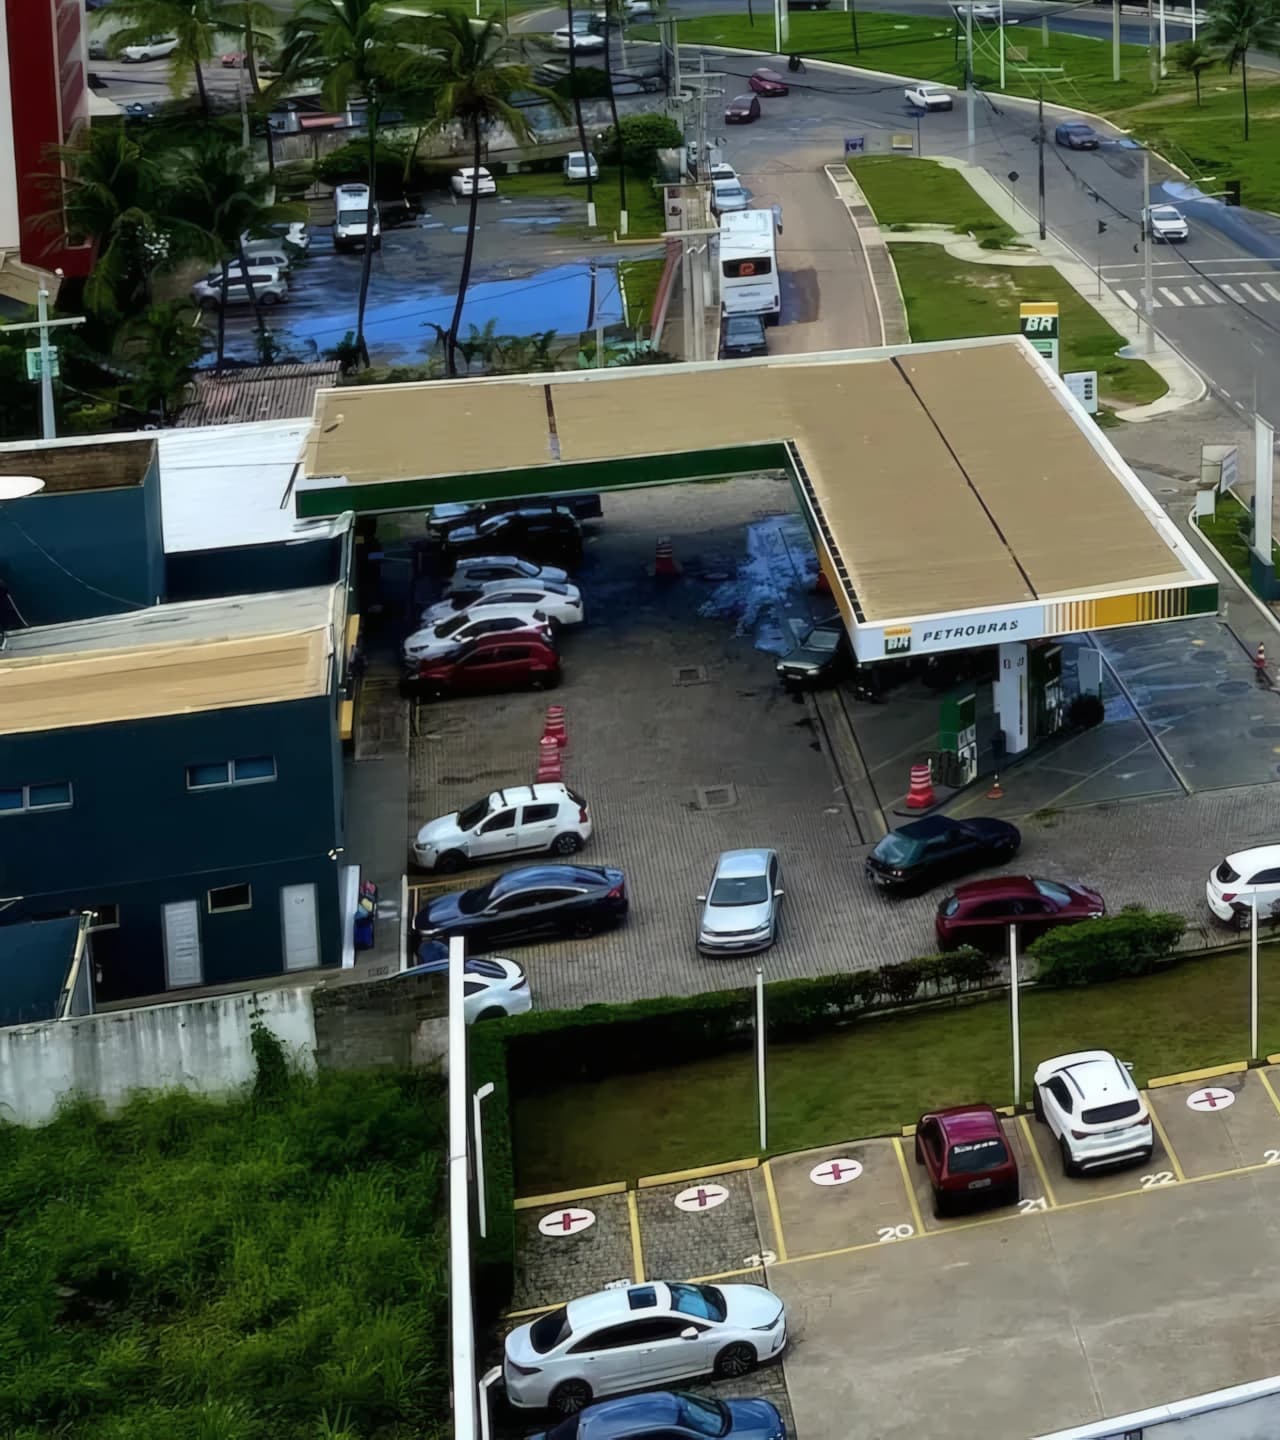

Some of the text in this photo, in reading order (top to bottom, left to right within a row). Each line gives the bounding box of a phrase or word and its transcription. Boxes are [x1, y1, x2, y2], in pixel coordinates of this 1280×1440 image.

[1025, 317, 1053, 331] BR
[922, 620, 1019, 642] PETROBRAS
[1140, 1171, 1177, 1190] 22
[1017, 1196, 1048, 1215] 21
[878, 1223, 914, 1243] 20
